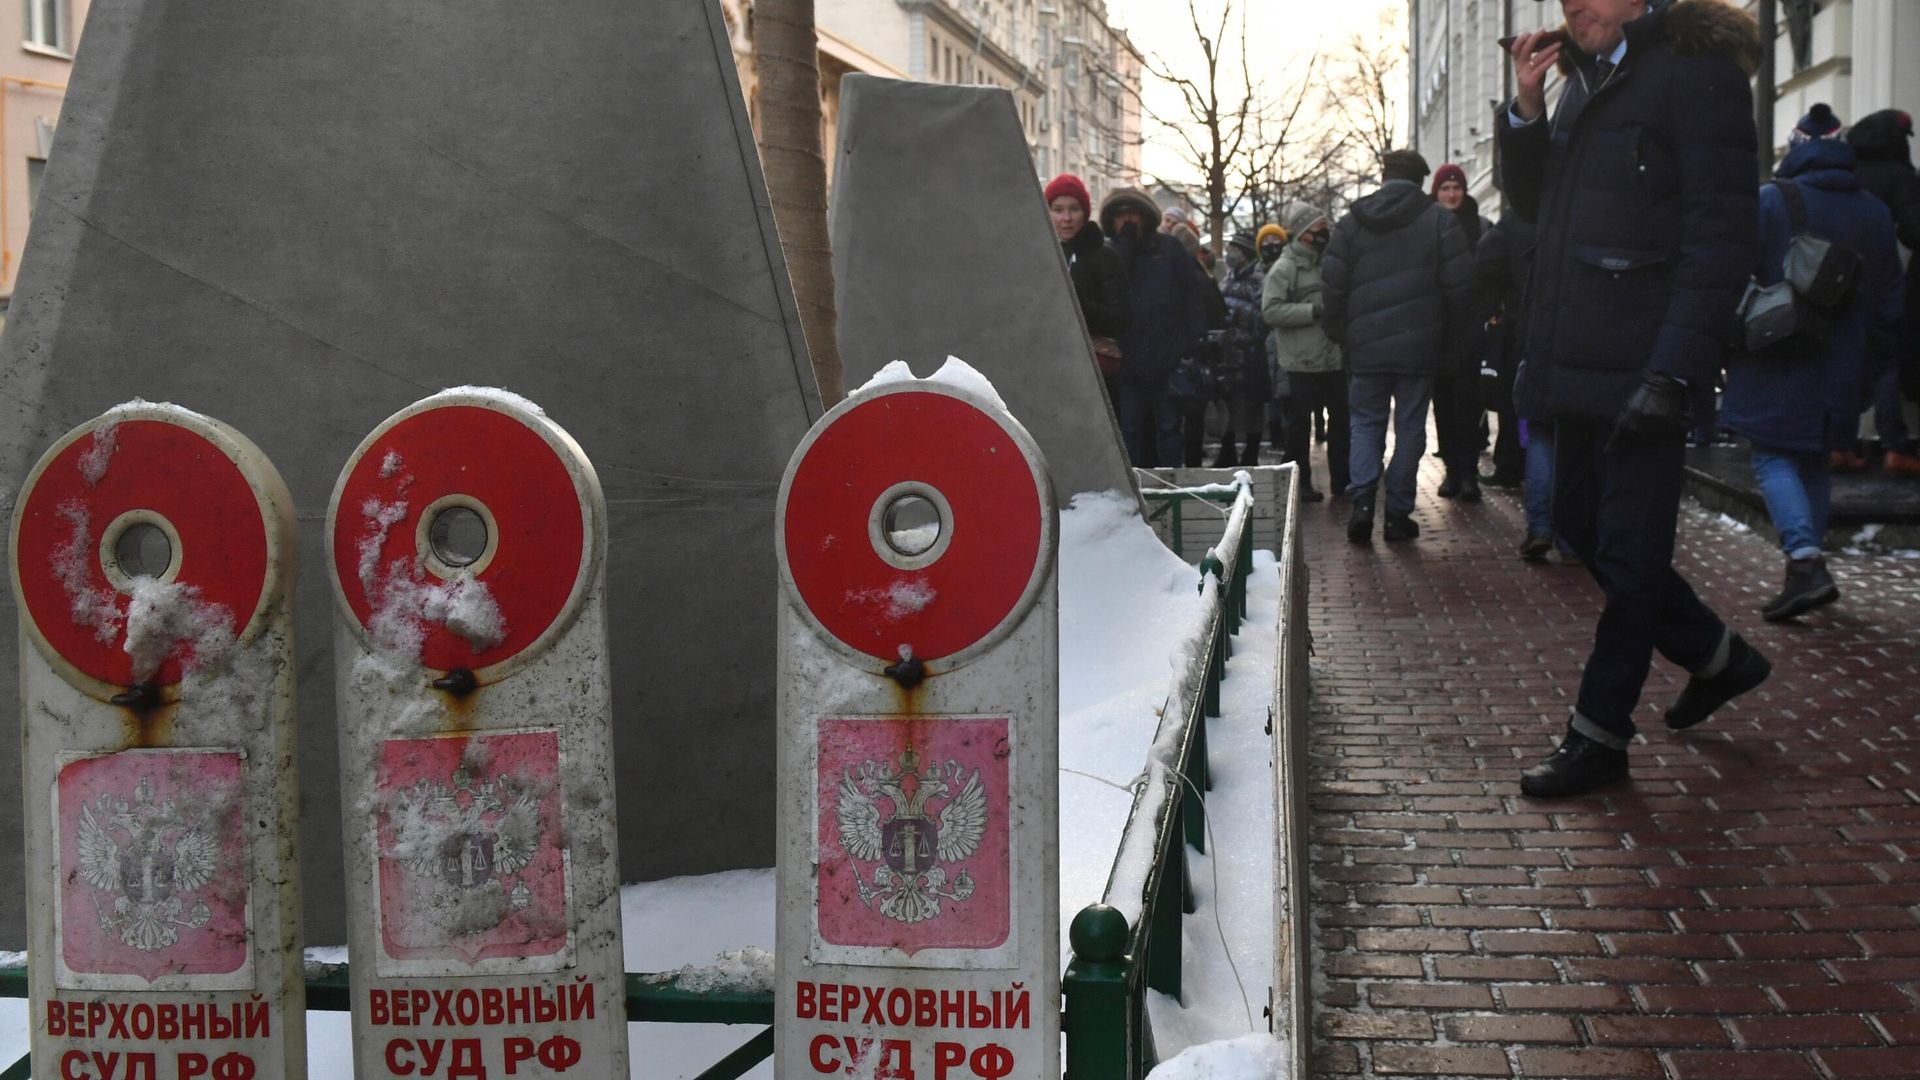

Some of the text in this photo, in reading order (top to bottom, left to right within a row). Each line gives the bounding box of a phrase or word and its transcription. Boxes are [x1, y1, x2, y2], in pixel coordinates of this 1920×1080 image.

[47, 993, 270, 1040] ВЕРХОВНЫЙ
[370, 975, 594, 1026] ВЕРХОВНЫЙ
[796, 981, 1030, 1029] ВЕРХОВНЫЙ
[60, 1050, 256, 1080] СУД РФ
[385, 1035, 582, 1080] СУД РФ
[809, 1034, 1015, 1080] СУД РФ
